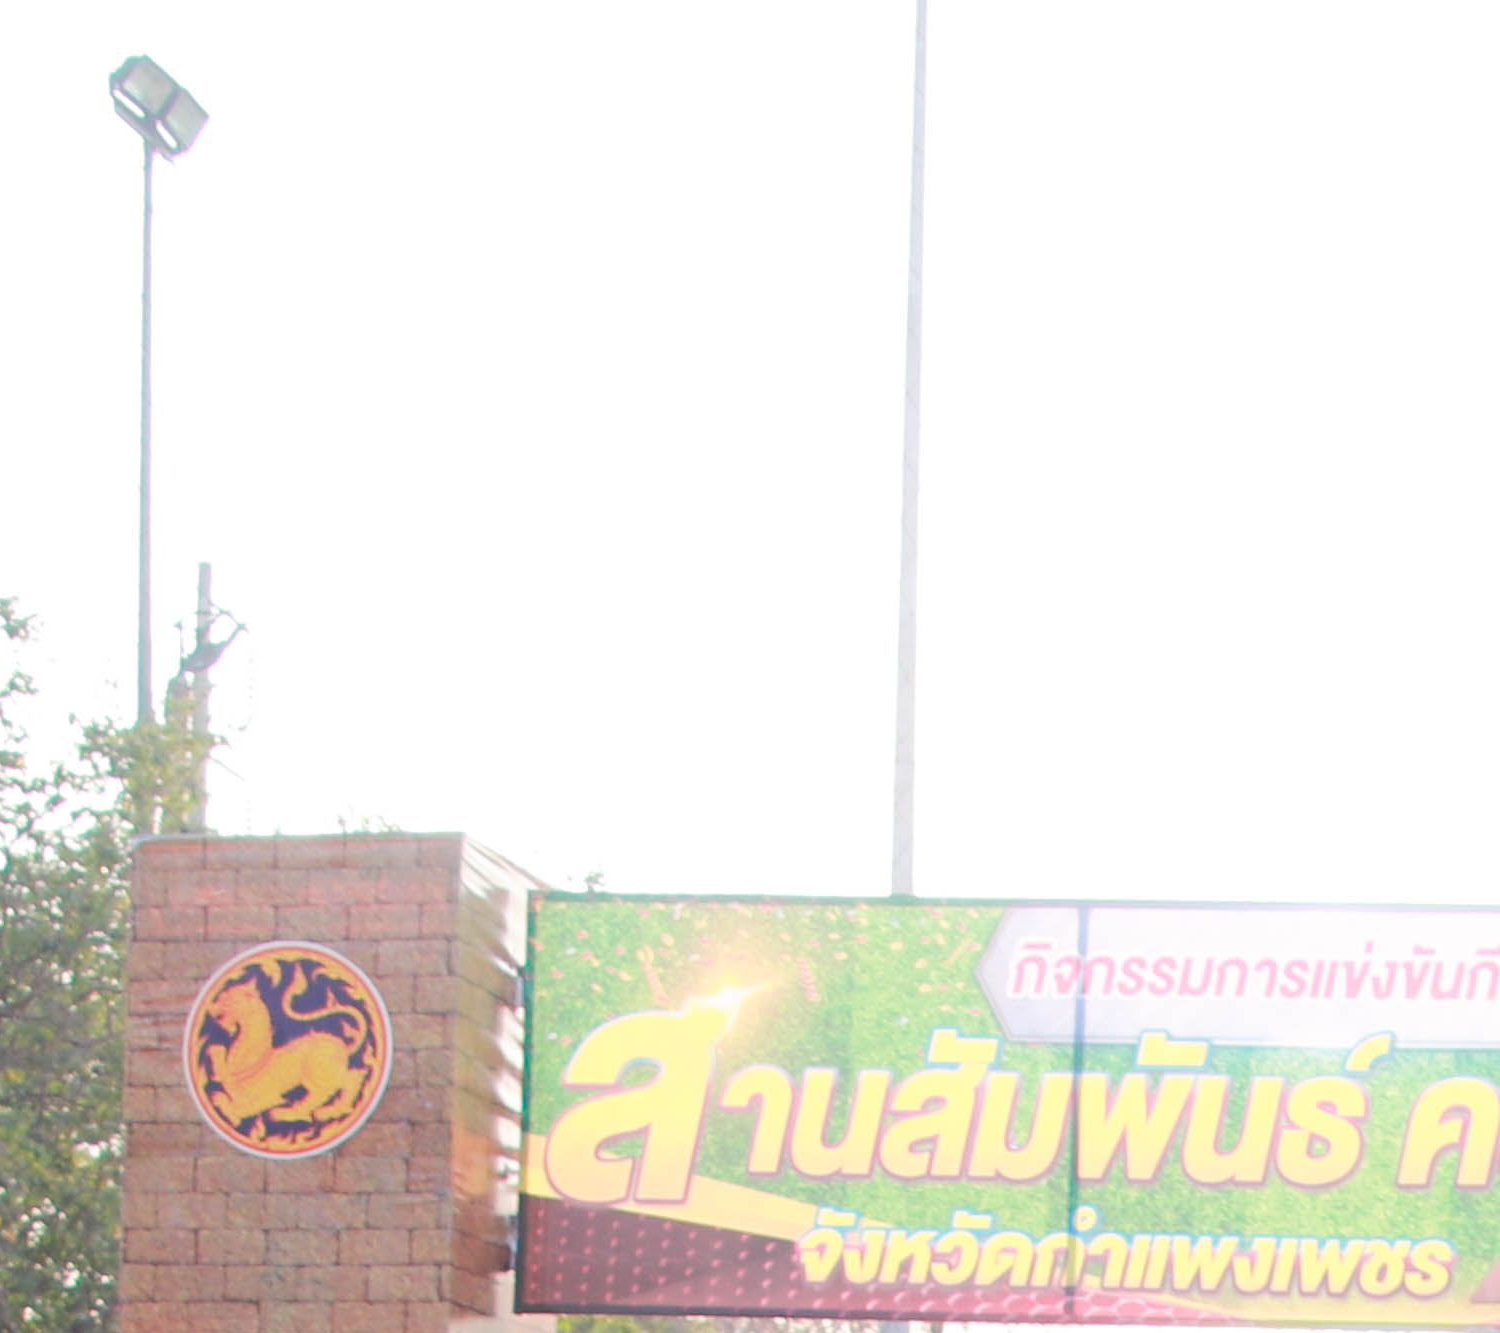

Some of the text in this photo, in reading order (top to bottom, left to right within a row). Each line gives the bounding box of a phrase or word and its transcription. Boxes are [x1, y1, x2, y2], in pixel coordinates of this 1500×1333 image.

[542, 1005, 1394, 1206] สานสัมพันธ์
[797, 1206, 1458, 1300] จังหวัดกำแพงเพชร
